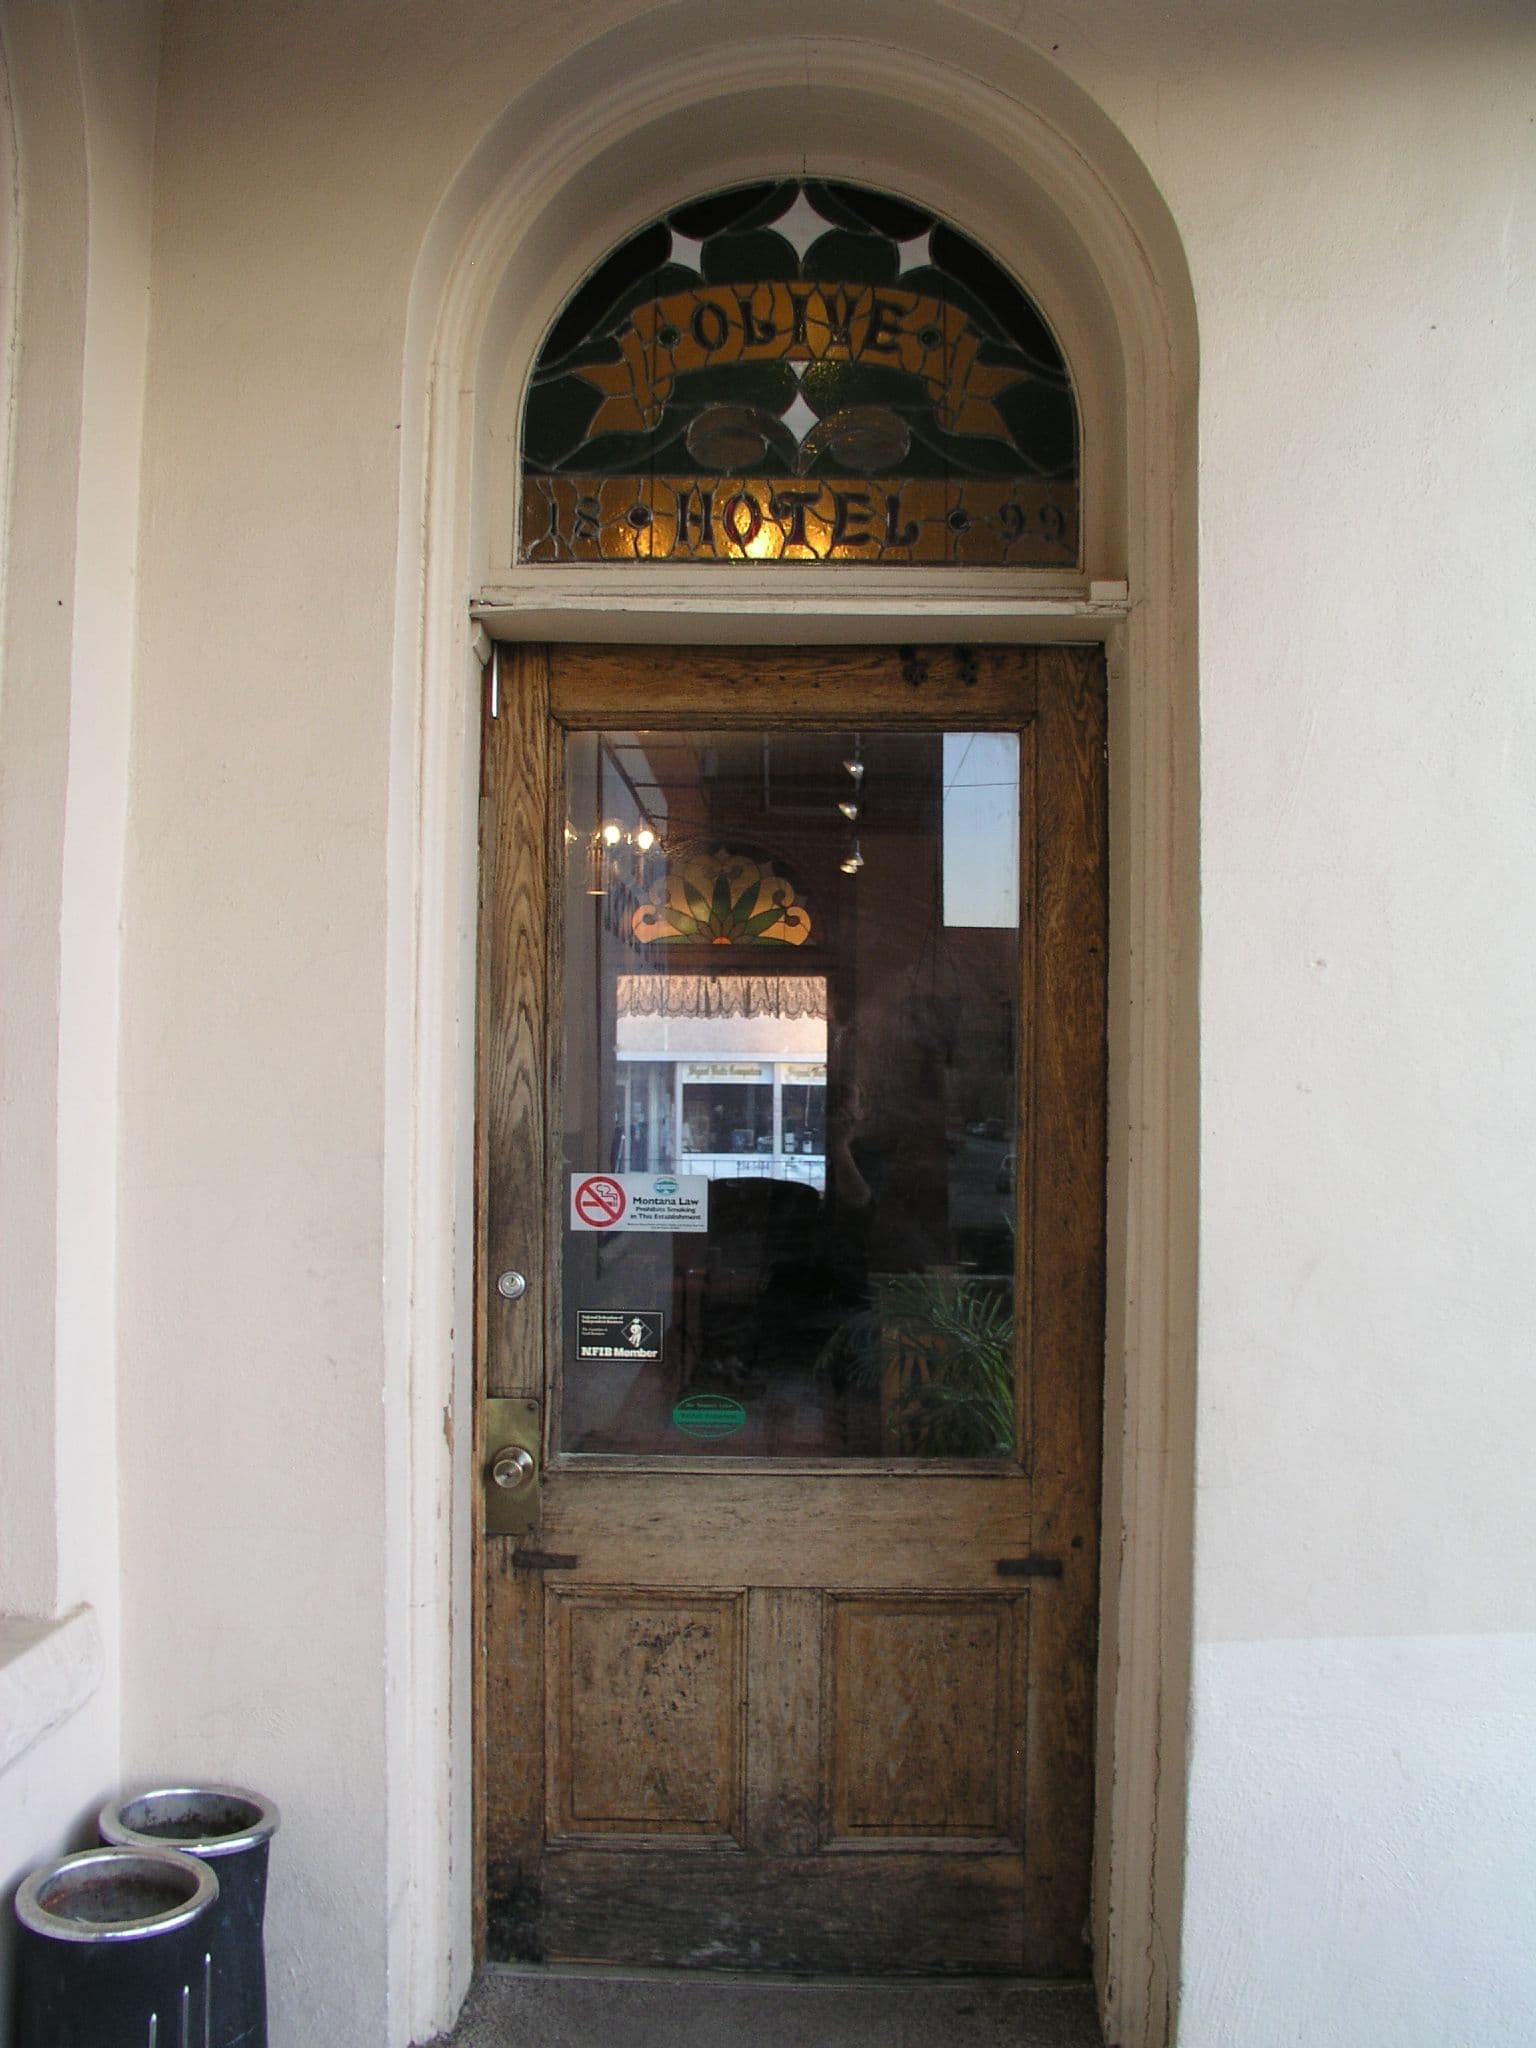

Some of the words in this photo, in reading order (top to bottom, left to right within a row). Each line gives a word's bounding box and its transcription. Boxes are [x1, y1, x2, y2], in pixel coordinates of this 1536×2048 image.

[691, 292, 904, 351] OLIVE
[546, 495, 601, 540] 18
[677, 492, 920, 547] HOTEL
[1000, 502, 1066, 542] 99
[632, 1196, 677, 1206] Montana
[679, 1196, 699, 1206] Law
[667, 1206, 696, 1214] Smoking
[580, 1346, 613, 1357] NFIB
[613, 1346, 659, 1358] Member
